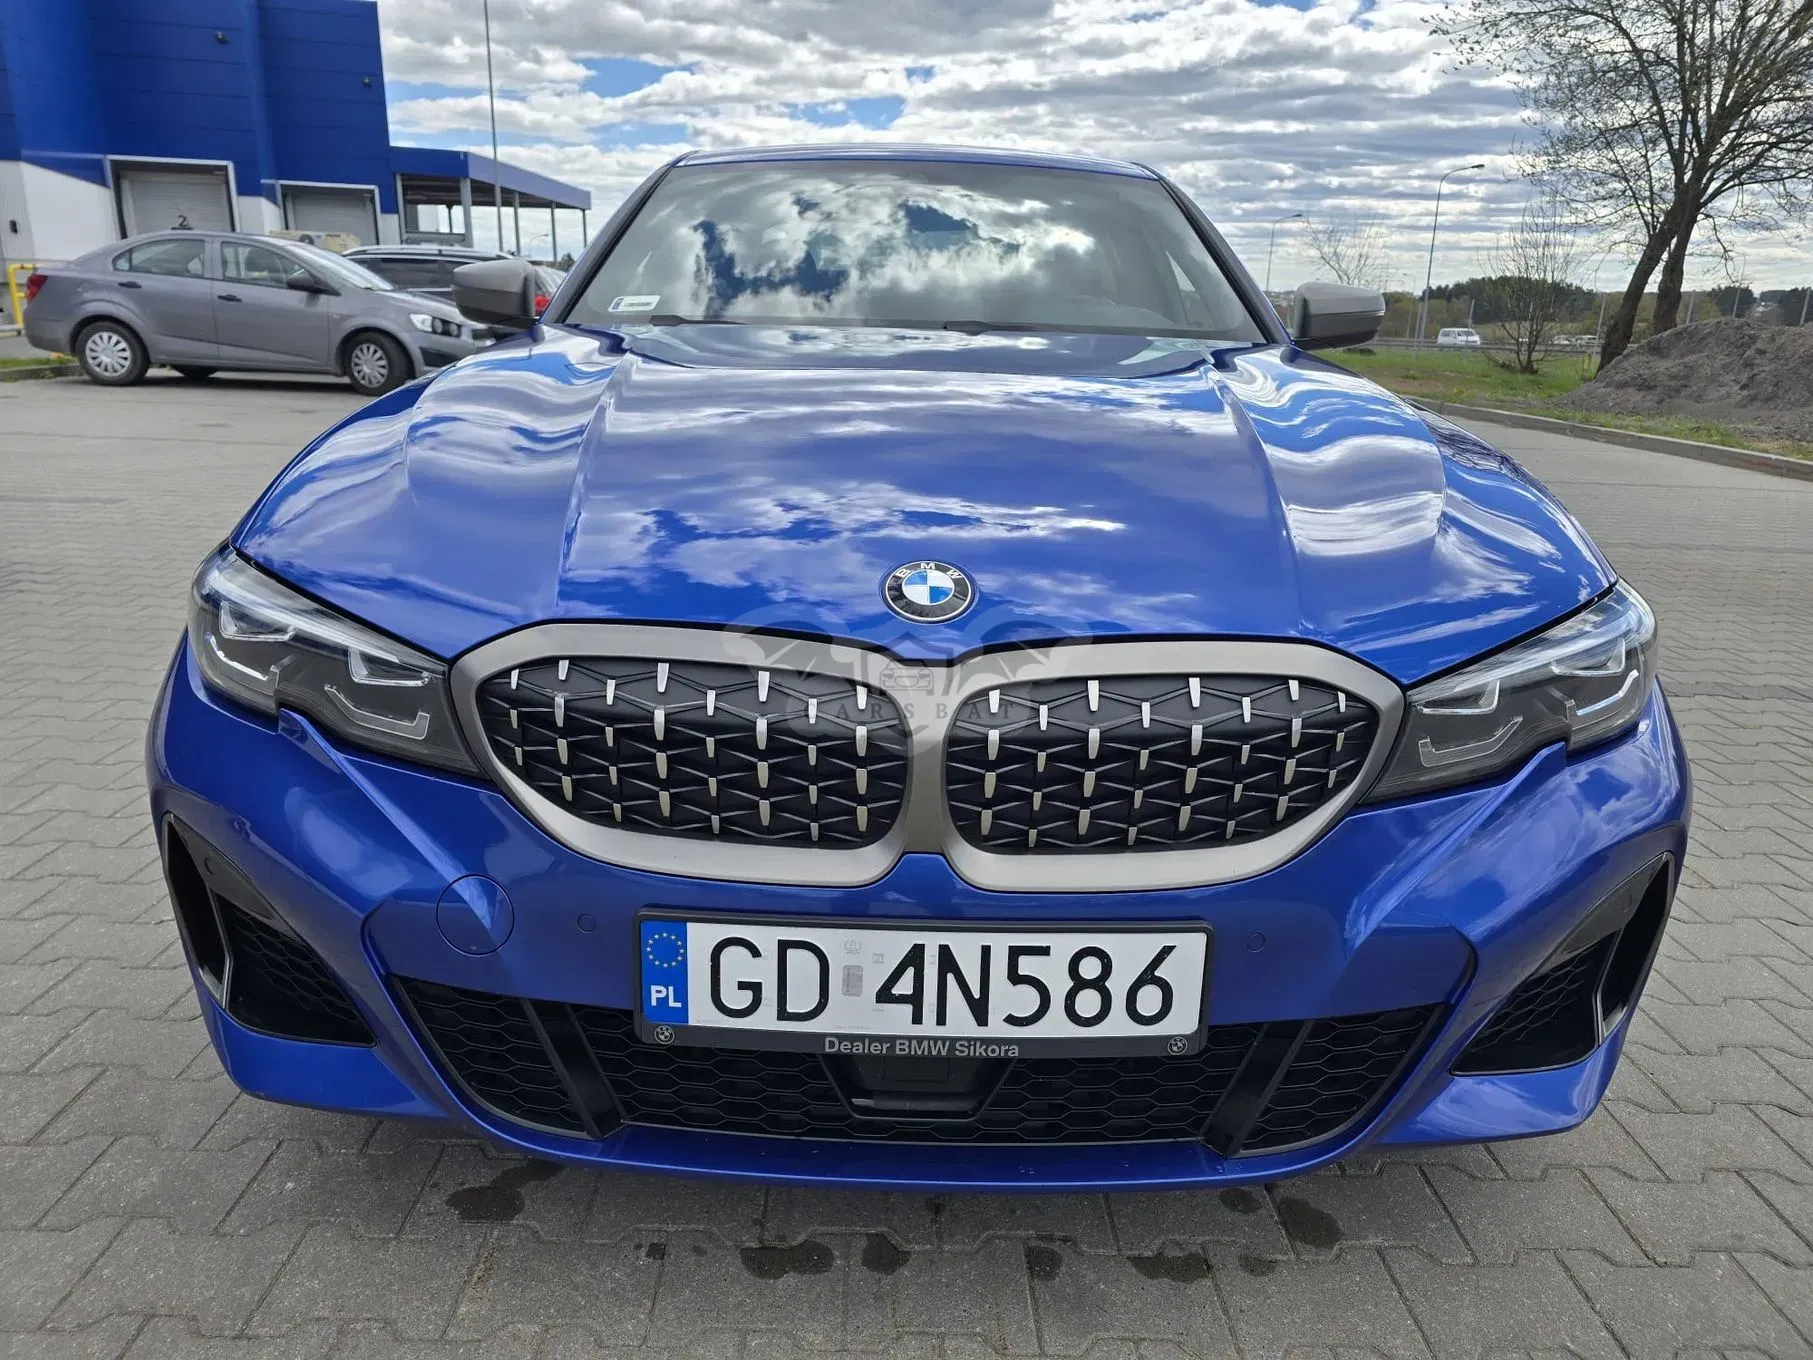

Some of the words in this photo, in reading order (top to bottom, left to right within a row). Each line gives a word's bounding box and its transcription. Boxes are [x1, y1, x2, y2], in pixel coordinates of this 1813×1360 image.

[895, 562, 962, 578] BMW
[710, 936, 830, 1022] GD
[875, 942, 1177, 1028] 4N586
[650, 984, 682, 1008] PL
[824, 1037, 890, 1055] Dealer
[895, 1039, 950, 1056] BMW
[954, 1040, 1019, 1058] Sikora
